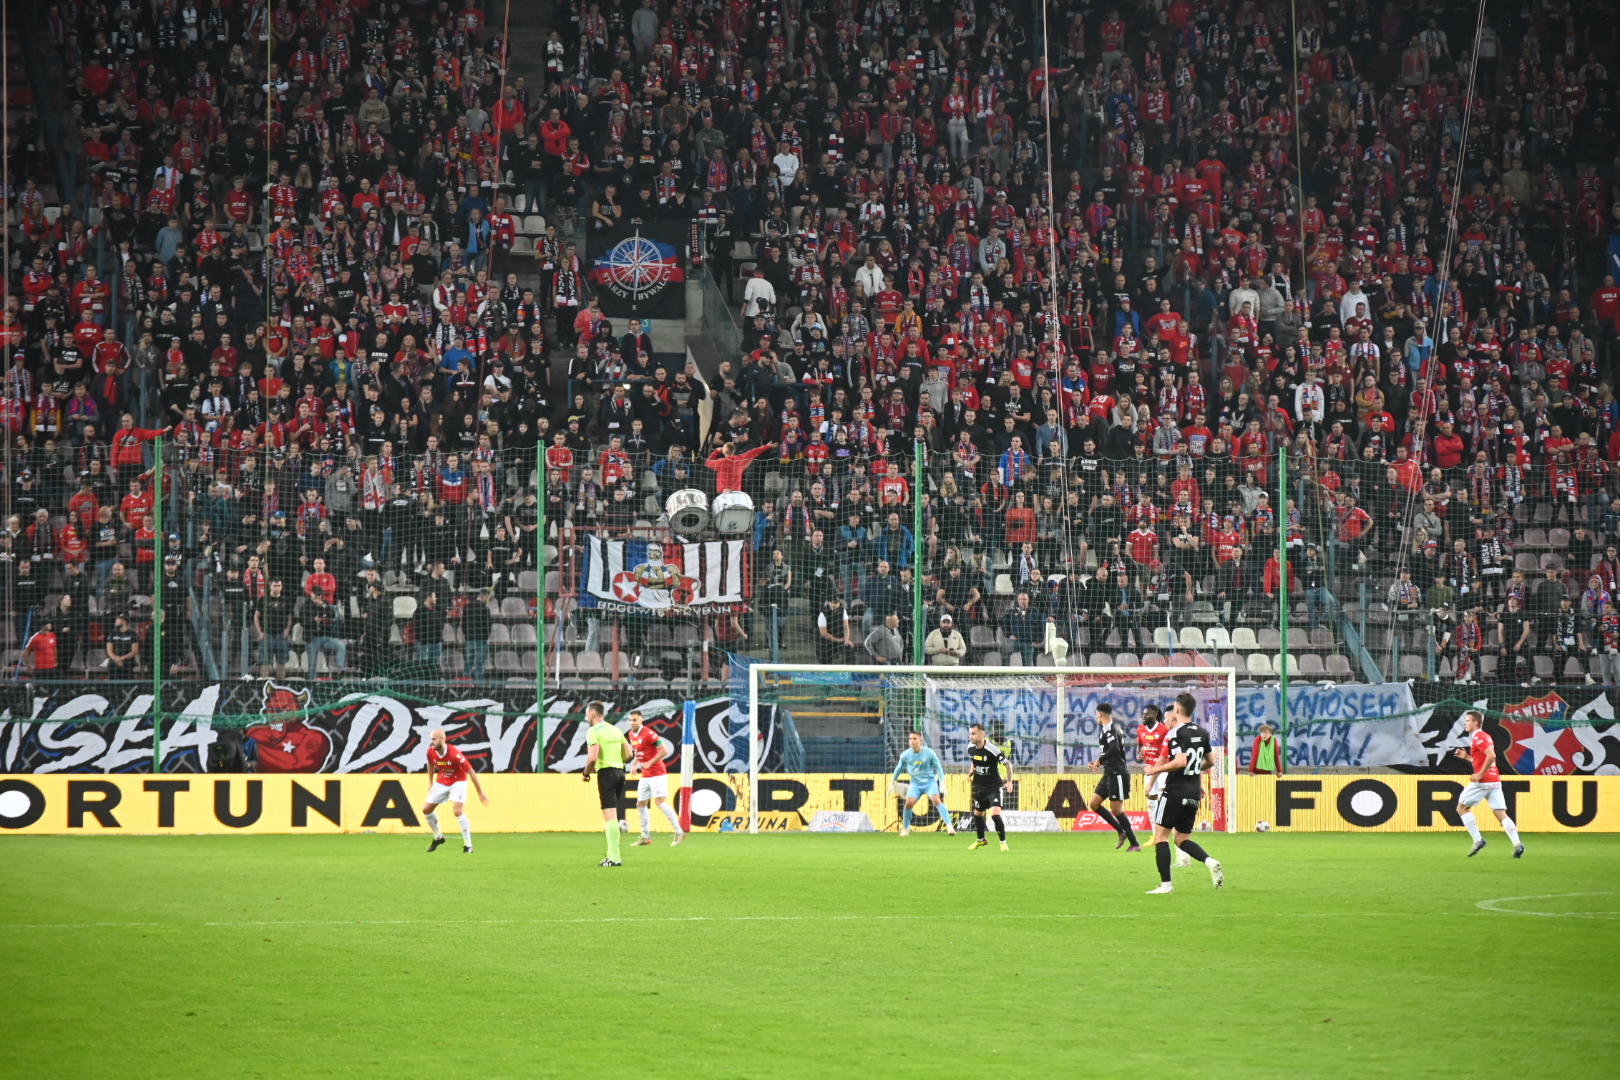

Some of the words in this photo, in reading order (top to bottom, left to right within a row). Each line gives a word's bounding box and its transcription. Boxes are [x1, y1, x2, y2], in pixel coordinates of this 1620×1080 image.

[602, 272, 629, 299] STARZY
[638, 269, 672, 301] BYWALCY
[1522, 701, 1560, 718] WISŁA
[1184, 747, 1204, 775] 28
[1541, 764, 1564, 775] 1906
